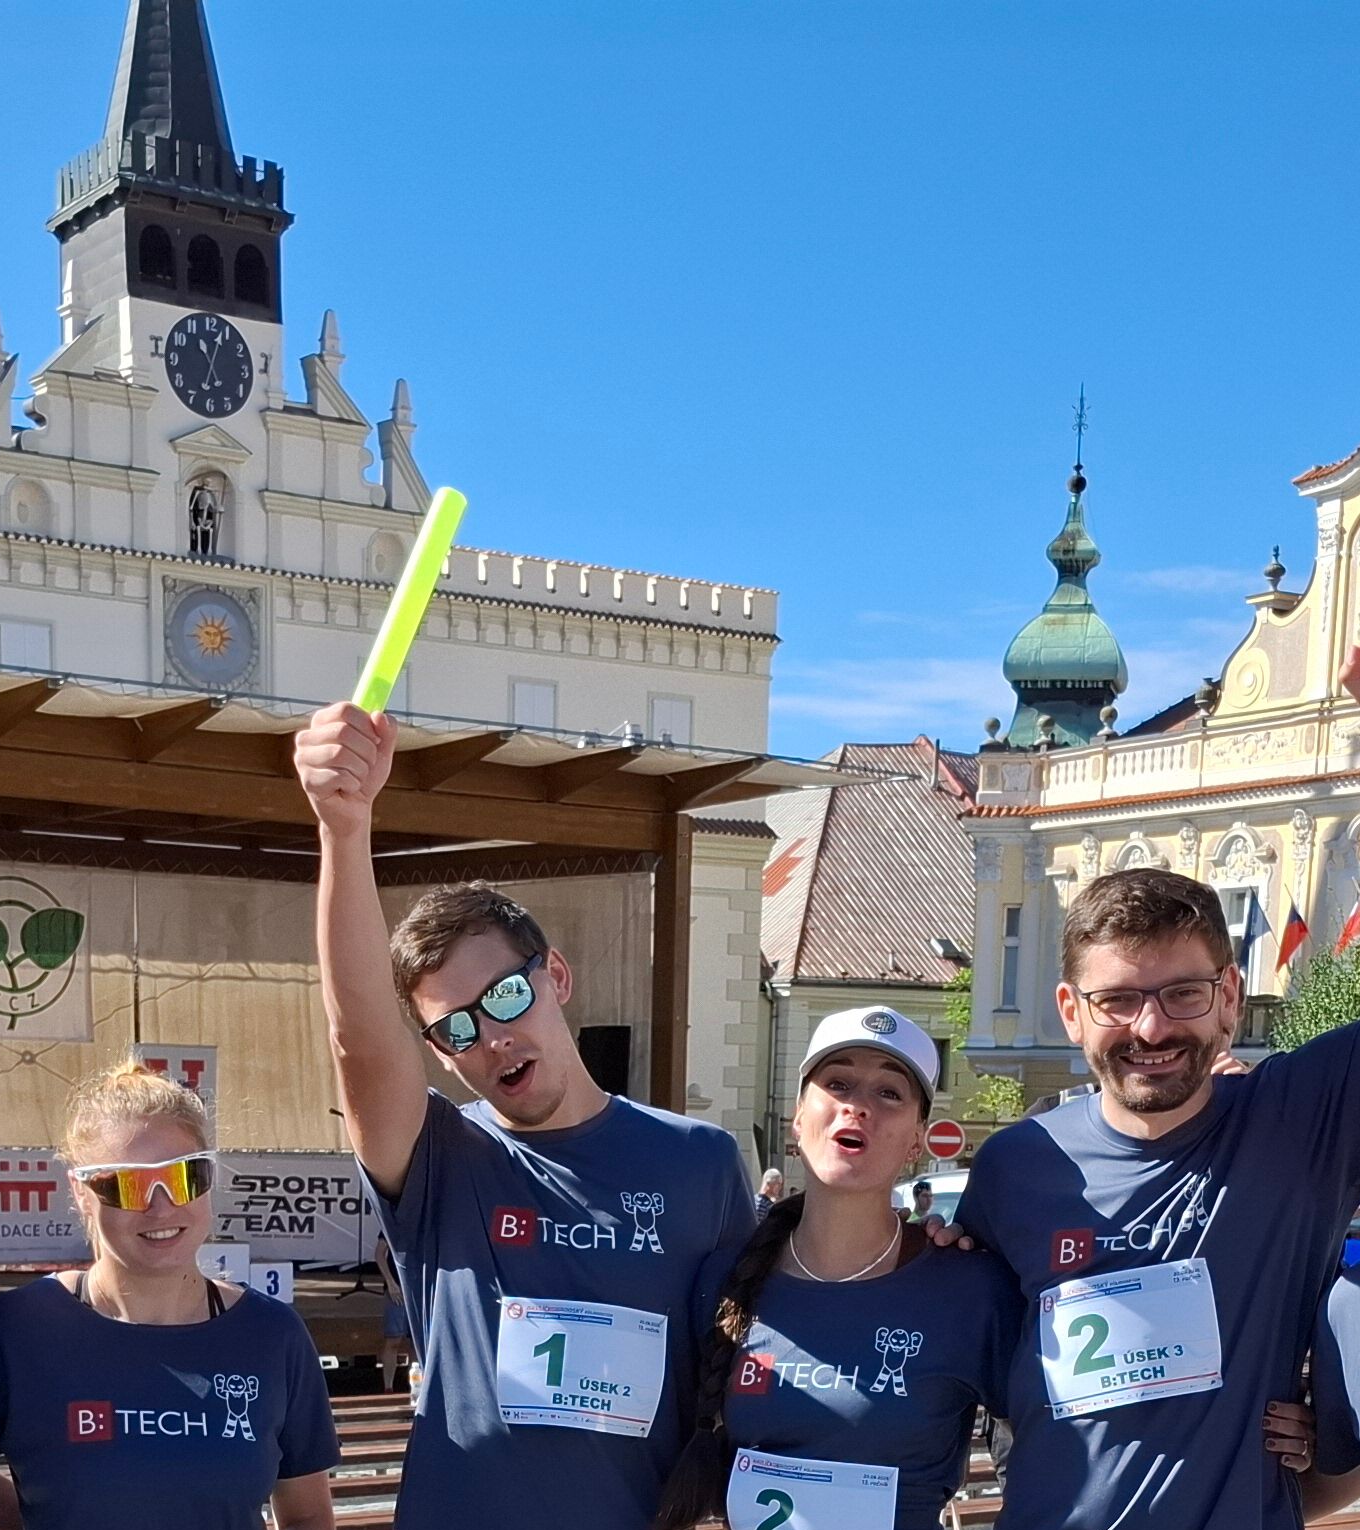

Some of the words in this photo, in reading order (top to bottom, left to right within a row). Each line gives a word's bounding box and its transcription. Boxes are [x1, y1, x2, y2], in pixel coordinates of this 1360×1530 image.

[205, 316, 218, 332] 12
[174, 331, 187, 347] 10
[169, 352, 179, 366] 9
[236, 343, 244, 358] 2
[174, 373, 184, 388] 8
[241, 365, 249, 379] 3
[187, 390, 197, 404] 7
[205, 398, 215, 412] 6
[223, 397, 232, 411] 5
[231, 1174, 351, 1196] SPORT
[46, 1219, 73, 1237] ČEZ
[217, 1212, 316, 1235] TEAM
[266, 1270, 280, 1296] 3
[1067, 1312, 1116, 1377] 2
[533, 1332, 567, 1388] 1
[1123, 1346, 1171, 1365] ÚSEK
[1173, 1344, 1184, 1357] 3
[1100, 1365, 1166, 1390] B:TECH
[579, 1377, 619, 1396] ÚSEK
[622, 1386, 631, 1397] 2
[552, 1393, 612, 1412] B:TECH
